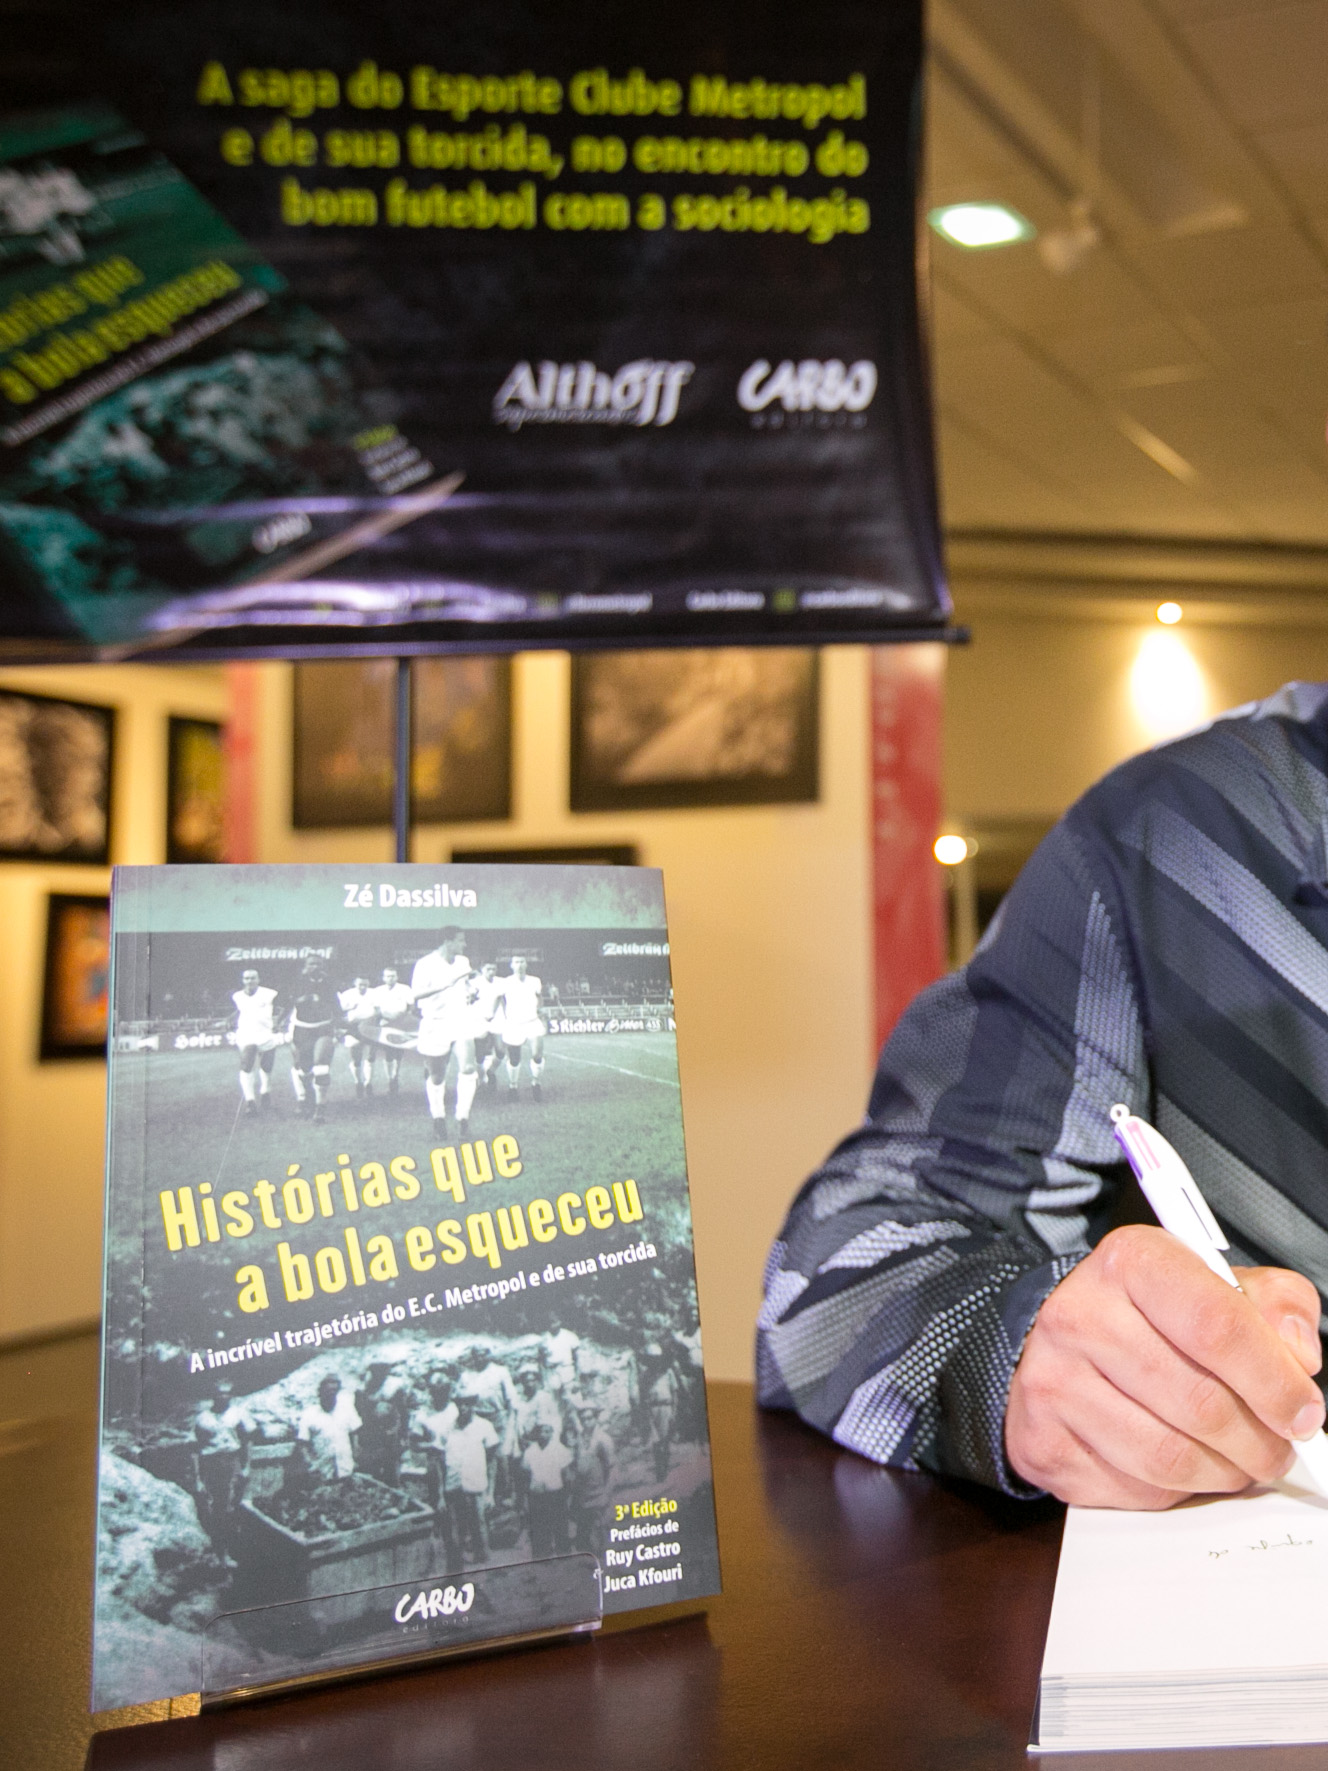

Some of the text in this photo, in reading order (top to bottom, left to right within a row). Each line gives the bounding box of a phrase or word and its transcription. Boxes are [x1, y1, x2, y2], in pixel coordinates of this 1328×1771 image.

[197, 59, 866, 130] A saga do Esporte Clube Metropol
[220, 117, 869, 180] e de sua torcida, no encontro do
[280, 175, 870, 244] bom futebol com a sociologia
[494, 359, 696, 427] Althoff
[737, 359, 878, 412] CARBO
[344, 883, 477, 907] Zé Dassilva
[160, 1134, 523, 1251] Histórias que
[235, 1179, 644, 1313] a bola esqueceu
[190, 1241, 657, 1373] A incrível trajetória do E.C. Metropol e de sua torcida
[610, 1519, 680, 1543] Prefácios de
[615, 1498, 677, 1521] 3ª Edição
[604, 1573, 636, 1593] Juca
[639, 1563, 683, 1586] Kfouri
[606, 1541, 681, 1567] Ruy Castro
[394, 1582, 475, 1623] CARBO
